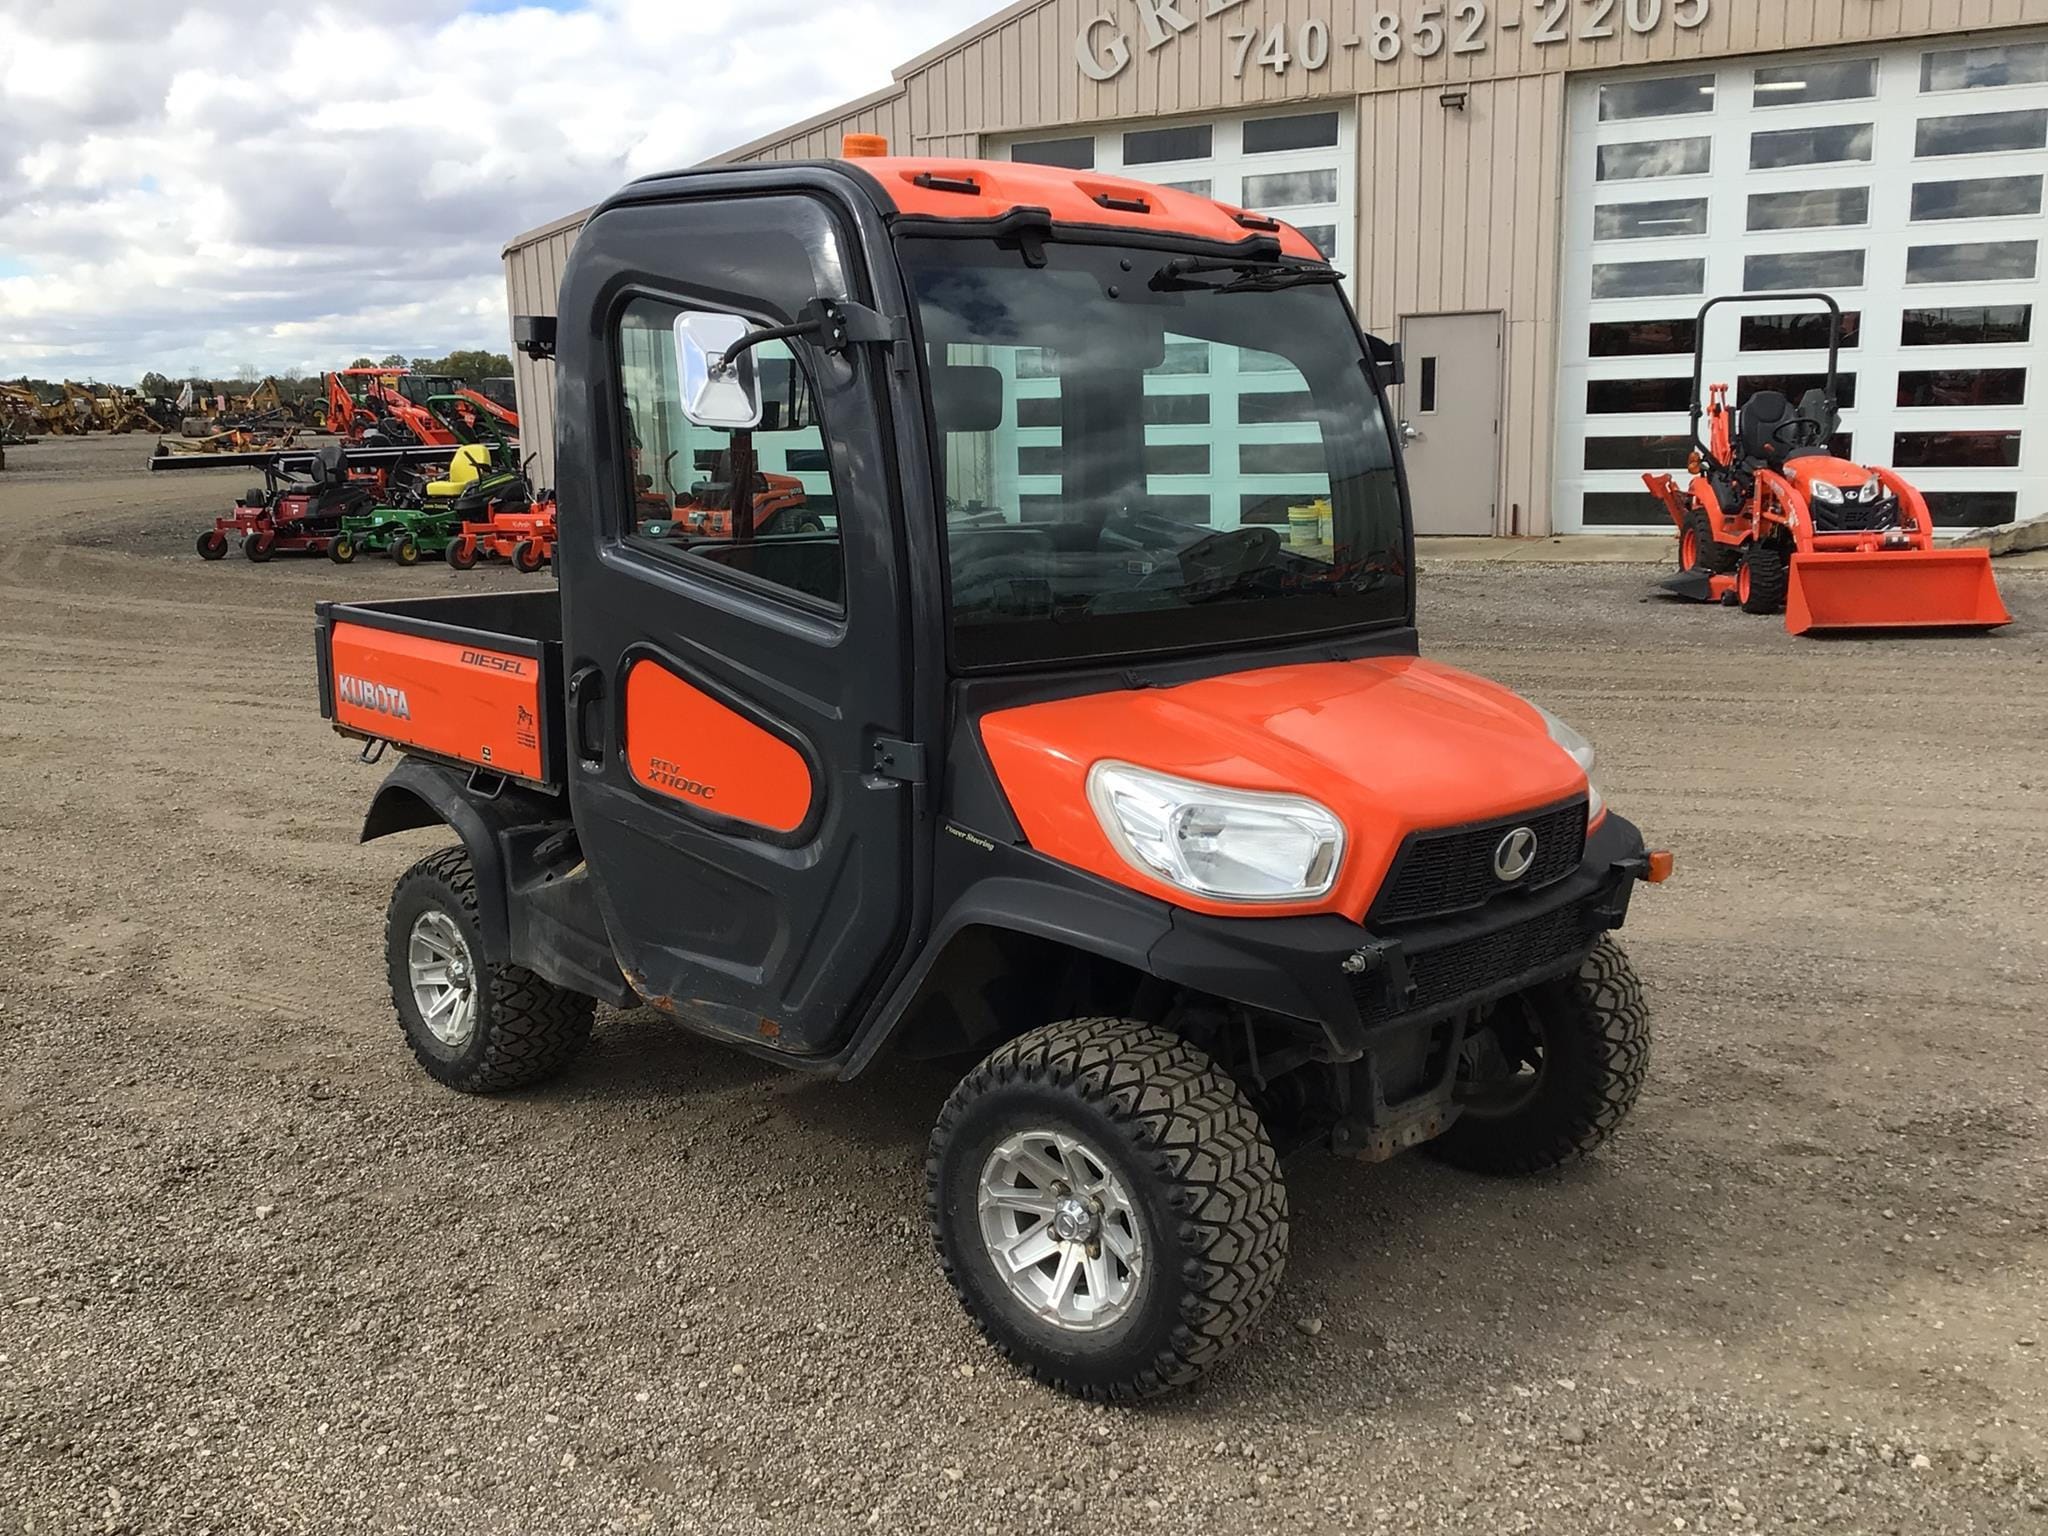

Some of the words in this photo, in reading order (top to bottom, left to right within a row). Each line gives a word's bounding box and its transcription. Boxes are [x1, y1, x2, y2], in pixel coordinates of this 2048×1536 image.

[461, 651, 527, 676] DIESEL
[339, 674, 411, 720] KUBOTA
[650, 758, 680, 774] RTV
[647, 768, 716, 799] X1100C
[945, 824, 967, 838] Power
[966, 833, 995, 851] Steering
